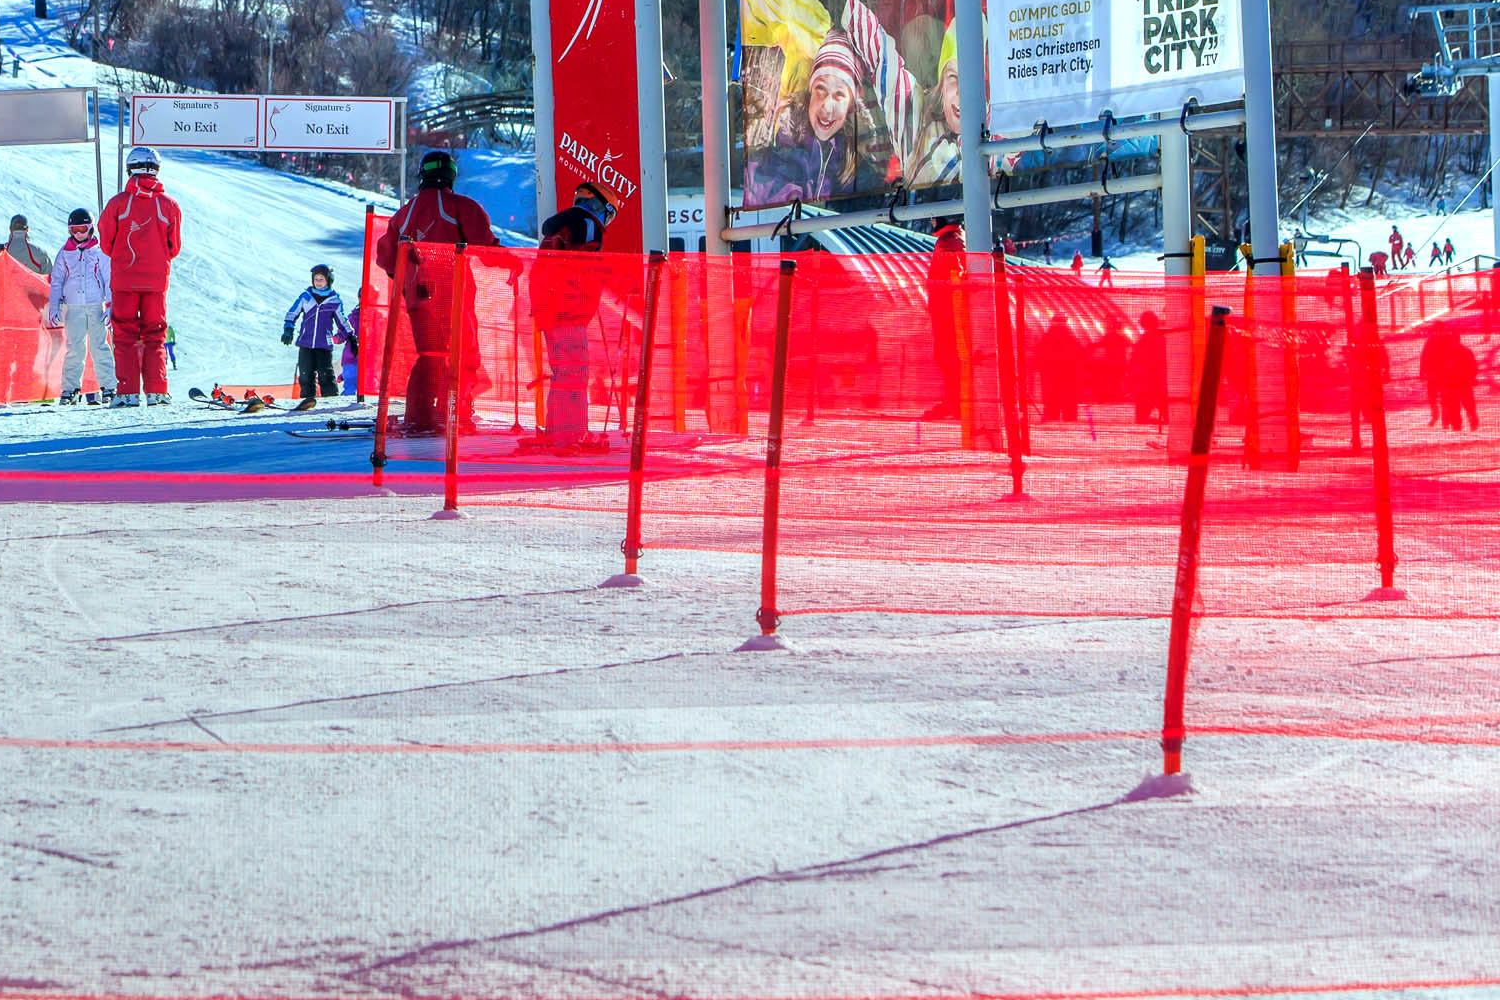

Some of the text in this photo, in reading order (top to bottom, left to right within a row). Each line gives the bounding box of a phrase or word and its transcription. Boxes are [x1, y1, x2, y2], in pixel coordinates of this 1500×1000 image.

[1009, 0, 1092, 23] OLYMPIC GOLD
[1008, 23, 1066, 42] MEDALIST
[1143, 6, 1219, 46] PARK
[1007, 38, 1101, 61] Joss Christensen
[1008, 58, 1094, 80] Rides Park City.
[173, 100, 219, 111] Signature 5
[305, 102, 351, 113] Signature 5
[174, 121, 217, 133] No Exit
[305, 123, 350, 135] No Exit
[558, 132, 637, 199] PARK CITY
